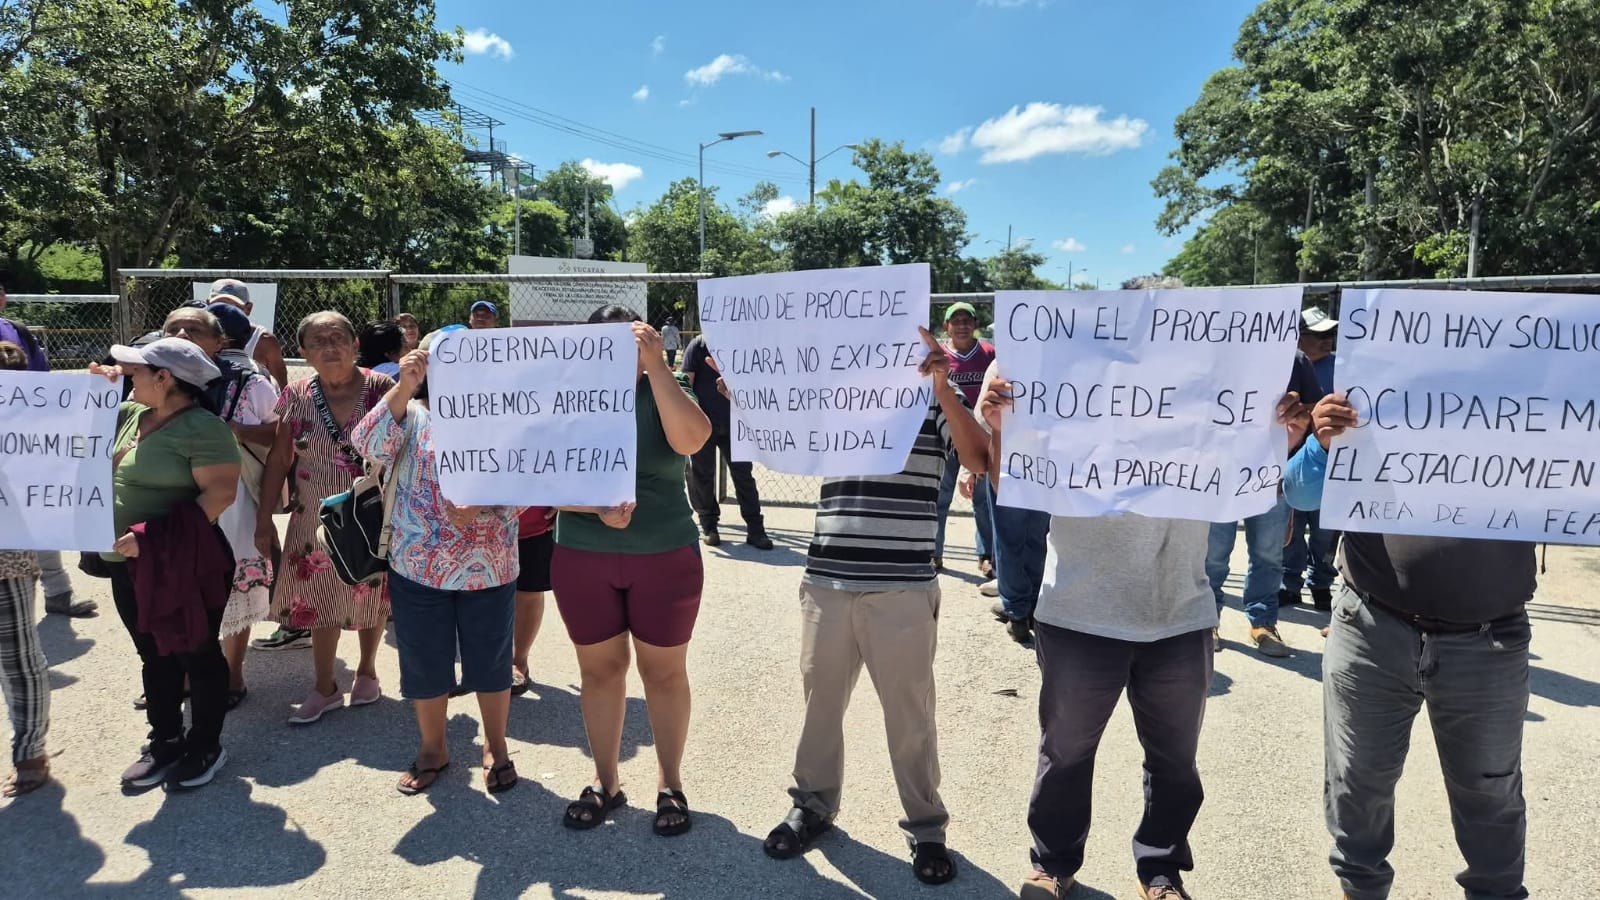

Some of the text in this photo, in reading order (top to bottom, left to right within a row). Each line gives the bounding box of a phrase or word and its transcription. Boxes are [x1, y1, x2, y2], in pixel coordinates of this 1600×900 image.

[701, 289, 909, 322] EL PLANO DE PROCEDE
[1009, 302, 1299, 343] CON EL PROGRAMA
[1345, 308, 1380, 341] SI
[1389, 310, 1431, 344] NO
[1444, 312, 1503, 349] HAY
[436, 336, 613, 364] GOBERNADOR
[732, 346, 786, 375] CLARA
[797, 347, 819, 373] NO
[830, 342, 921, 370] EXISTE
[84, 389, 118, 409] NO
[438, 389, 634, 419] QUEREMOS ARREGLO
[788, 386, 931, 412] EXPROPIACION
[1010, 380, 1258, 425] PROCEDE SE
[1344, 385, 1600, 433] OCUPAREM
[808, 429, 893, 452] EJIDAL
[439, 447, 628, 476] ANTES DE LA FERIA
[1008, 452, 1057, 489] CREO
[1068, 462, 1102, 490] LA
[1113, 458, 1221, 496] PARCELA
[1328, 446, 1362, 482] EL
[27, 485, 104, 507] FERIA
[1349, 500, 1414, 520] AREA
[1433, 503, 1468, 525] DE
[1487, 508, 1519, 529] LA
